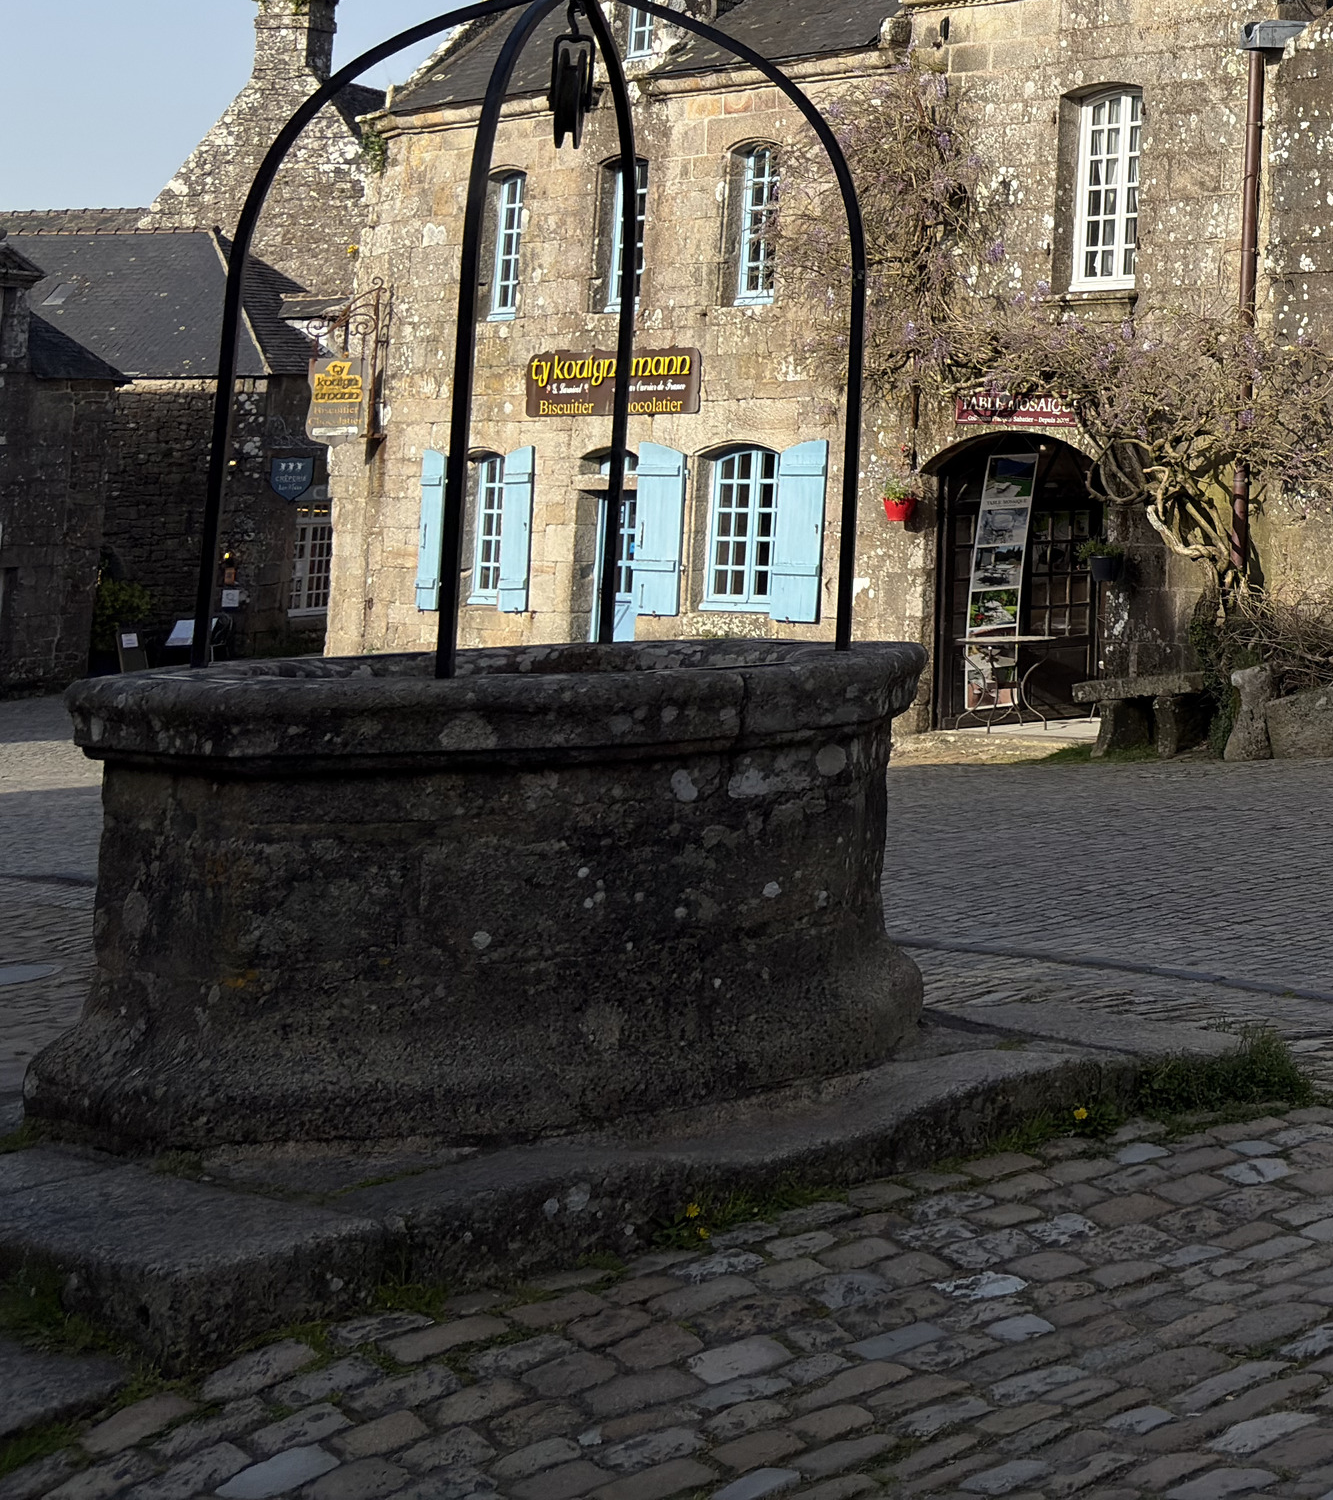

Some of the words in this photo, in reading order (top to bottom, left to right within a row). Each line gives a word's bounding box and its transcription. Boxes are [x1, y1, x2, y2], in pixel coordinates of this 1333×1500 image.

[531, 357, 551, 387] ty
[553, 354, 617, 386] kouign
[631, 355, 690, 377] mann
[539, 399, 595, 415] Biscuitier
[961, 396, 1005, 411] TABLE
